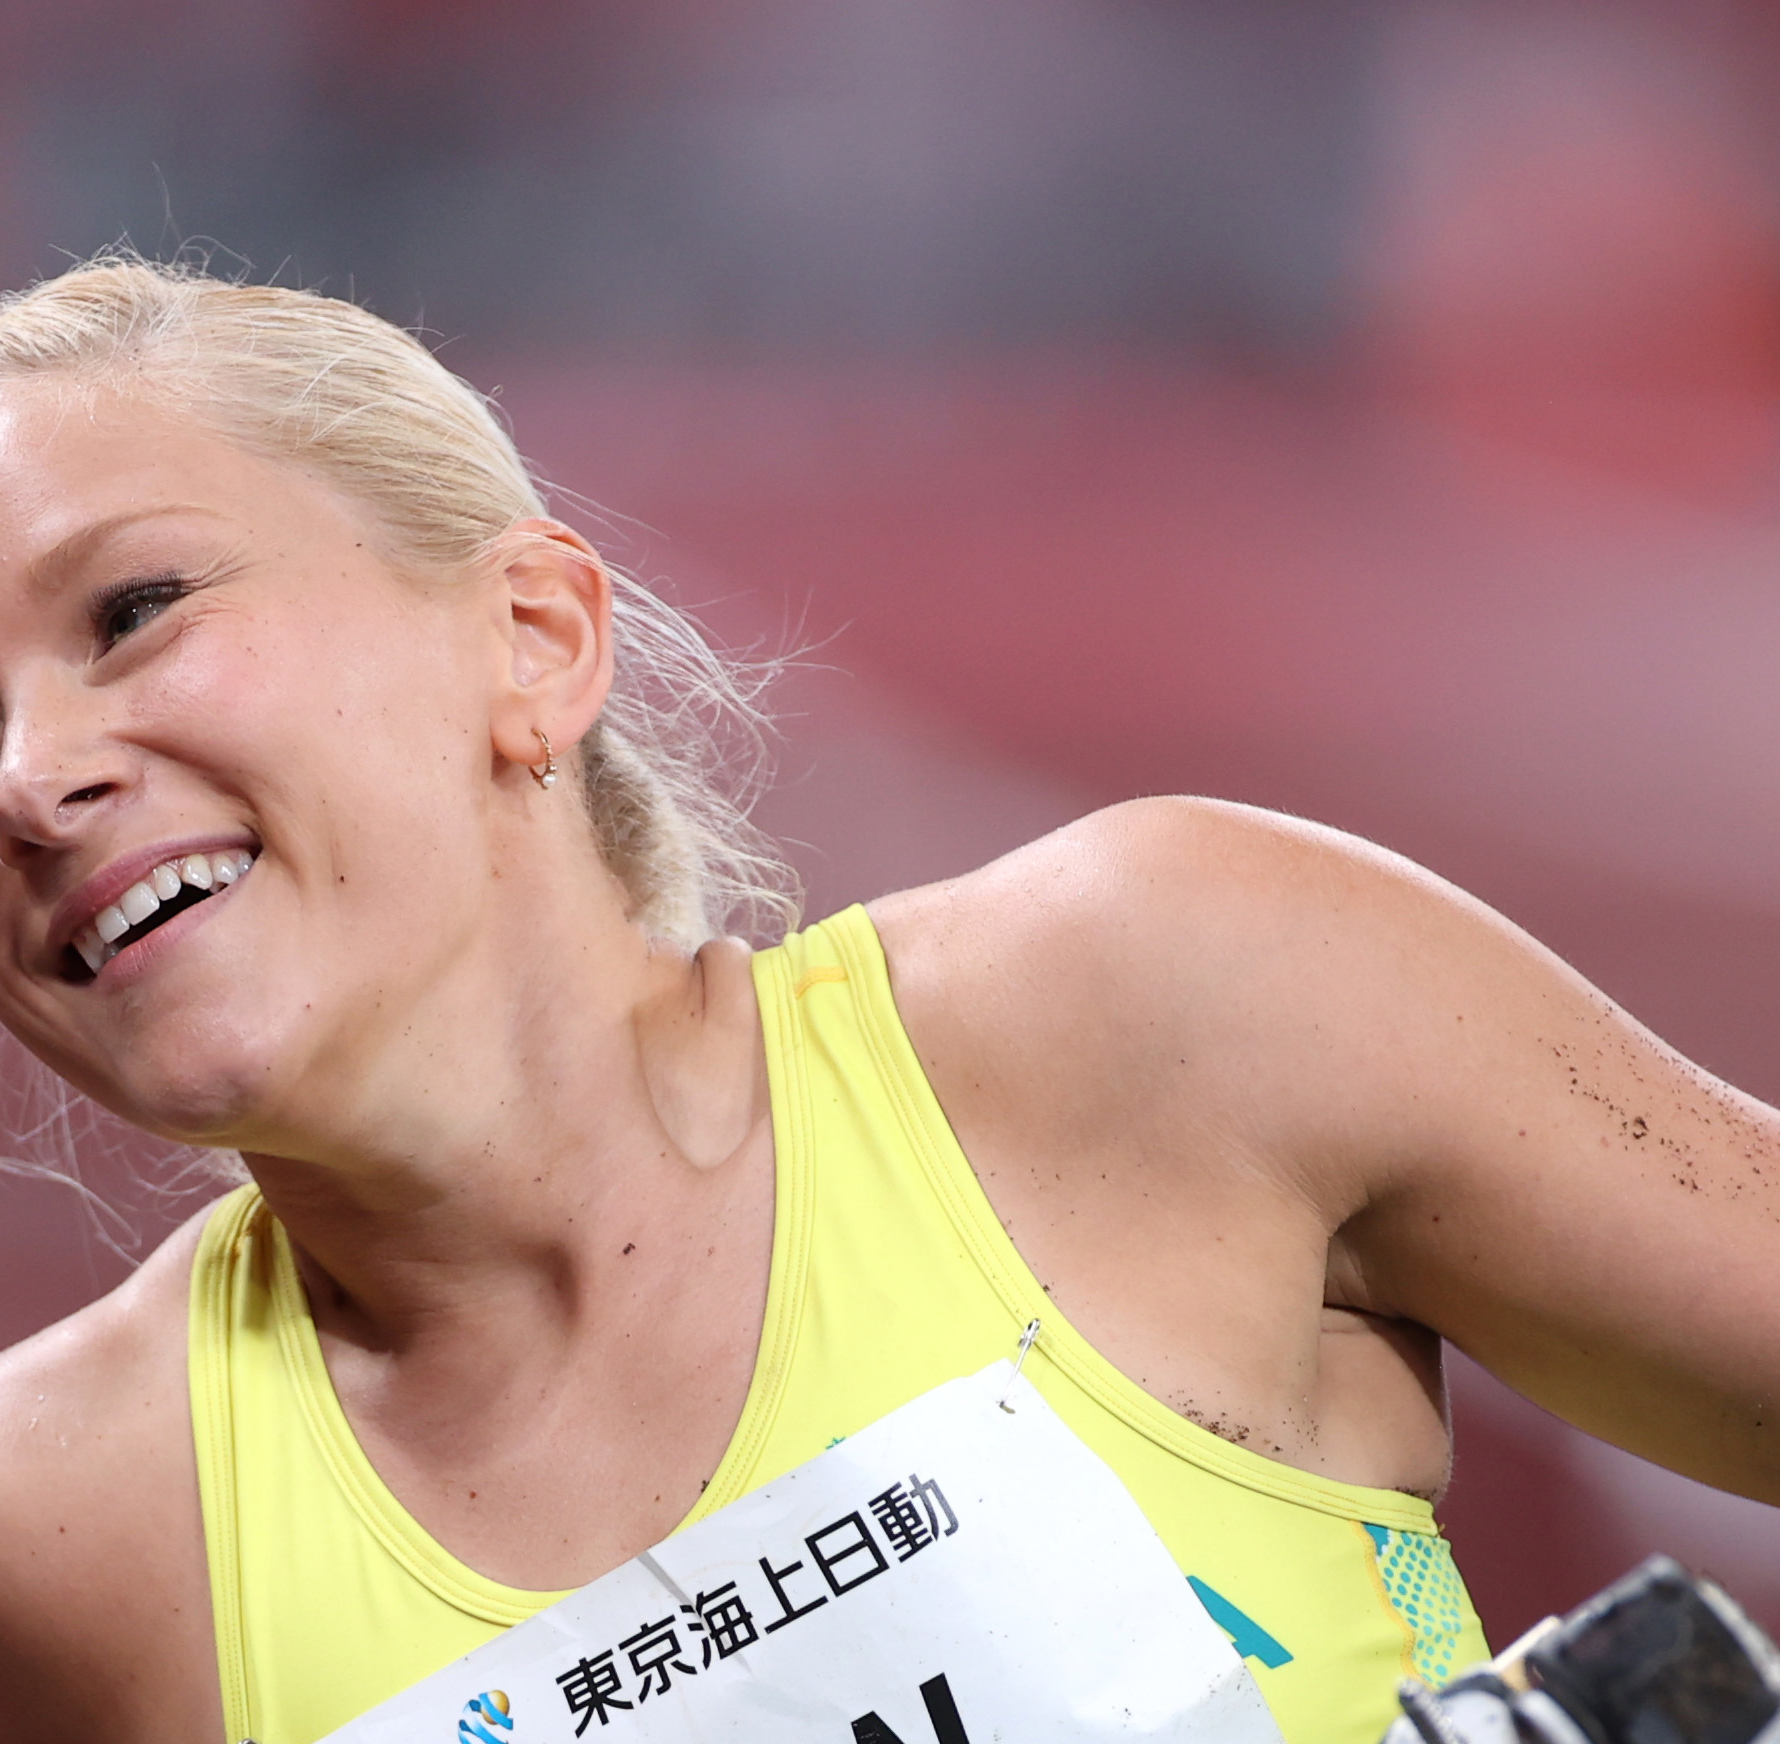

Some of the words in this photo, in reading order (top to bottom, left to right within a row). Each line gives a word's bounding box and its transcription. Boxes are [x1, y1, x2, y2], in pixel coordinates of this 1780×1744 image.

[556, 1473, 960, 1739] 東京海上日動
